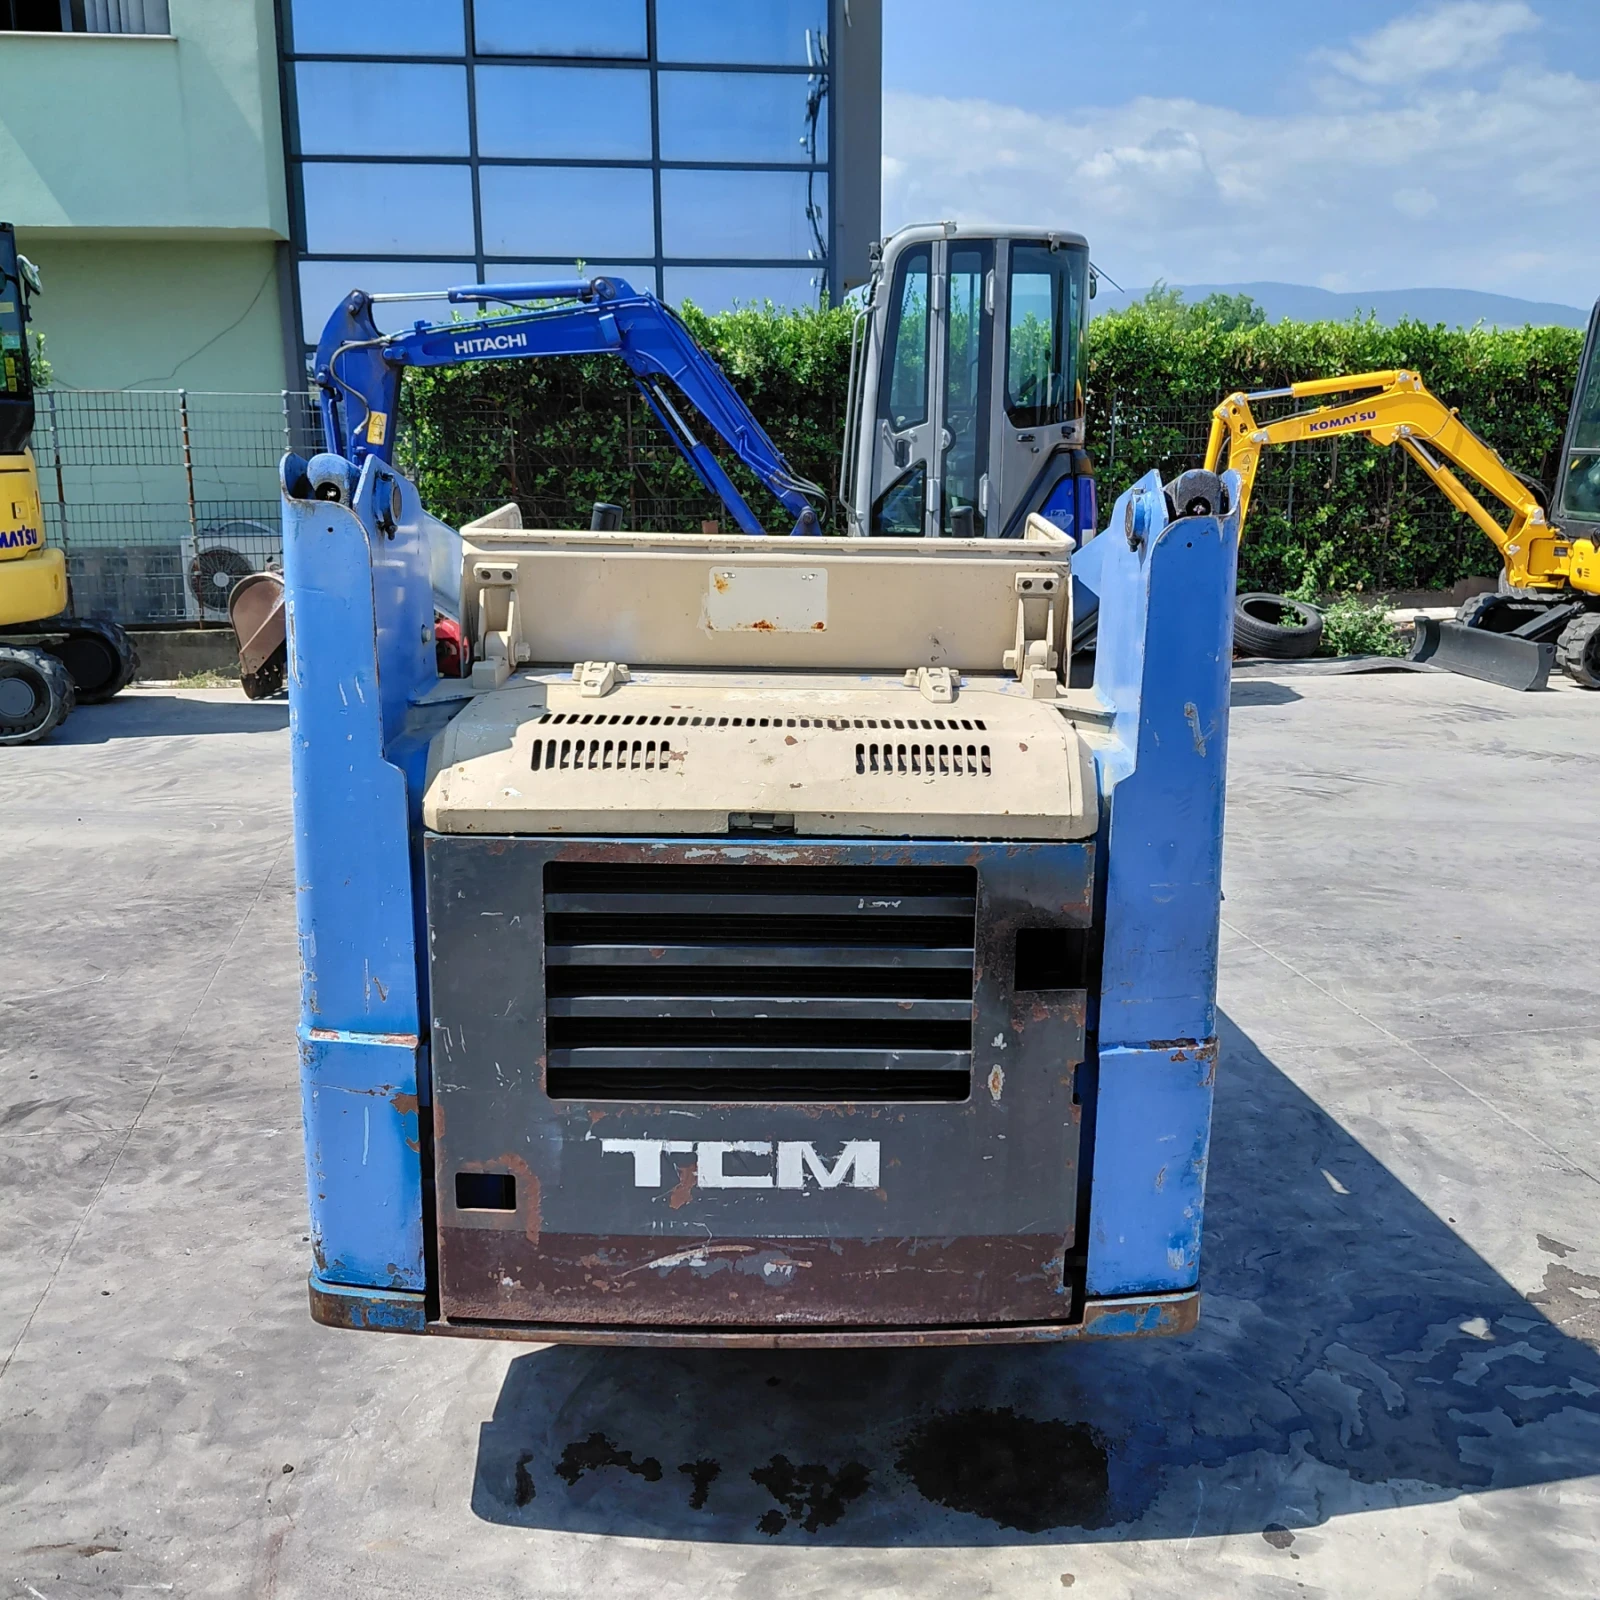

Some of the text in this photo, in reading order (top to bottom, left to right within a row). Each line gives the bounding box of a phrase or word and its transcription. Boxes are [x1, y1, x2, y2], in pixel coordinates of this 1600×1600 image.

[454, 333, 527, 355] HITACHI
[1309, 410, 1377, 432] KOMATSU
[601, 1138, 881, 1190] TCM
